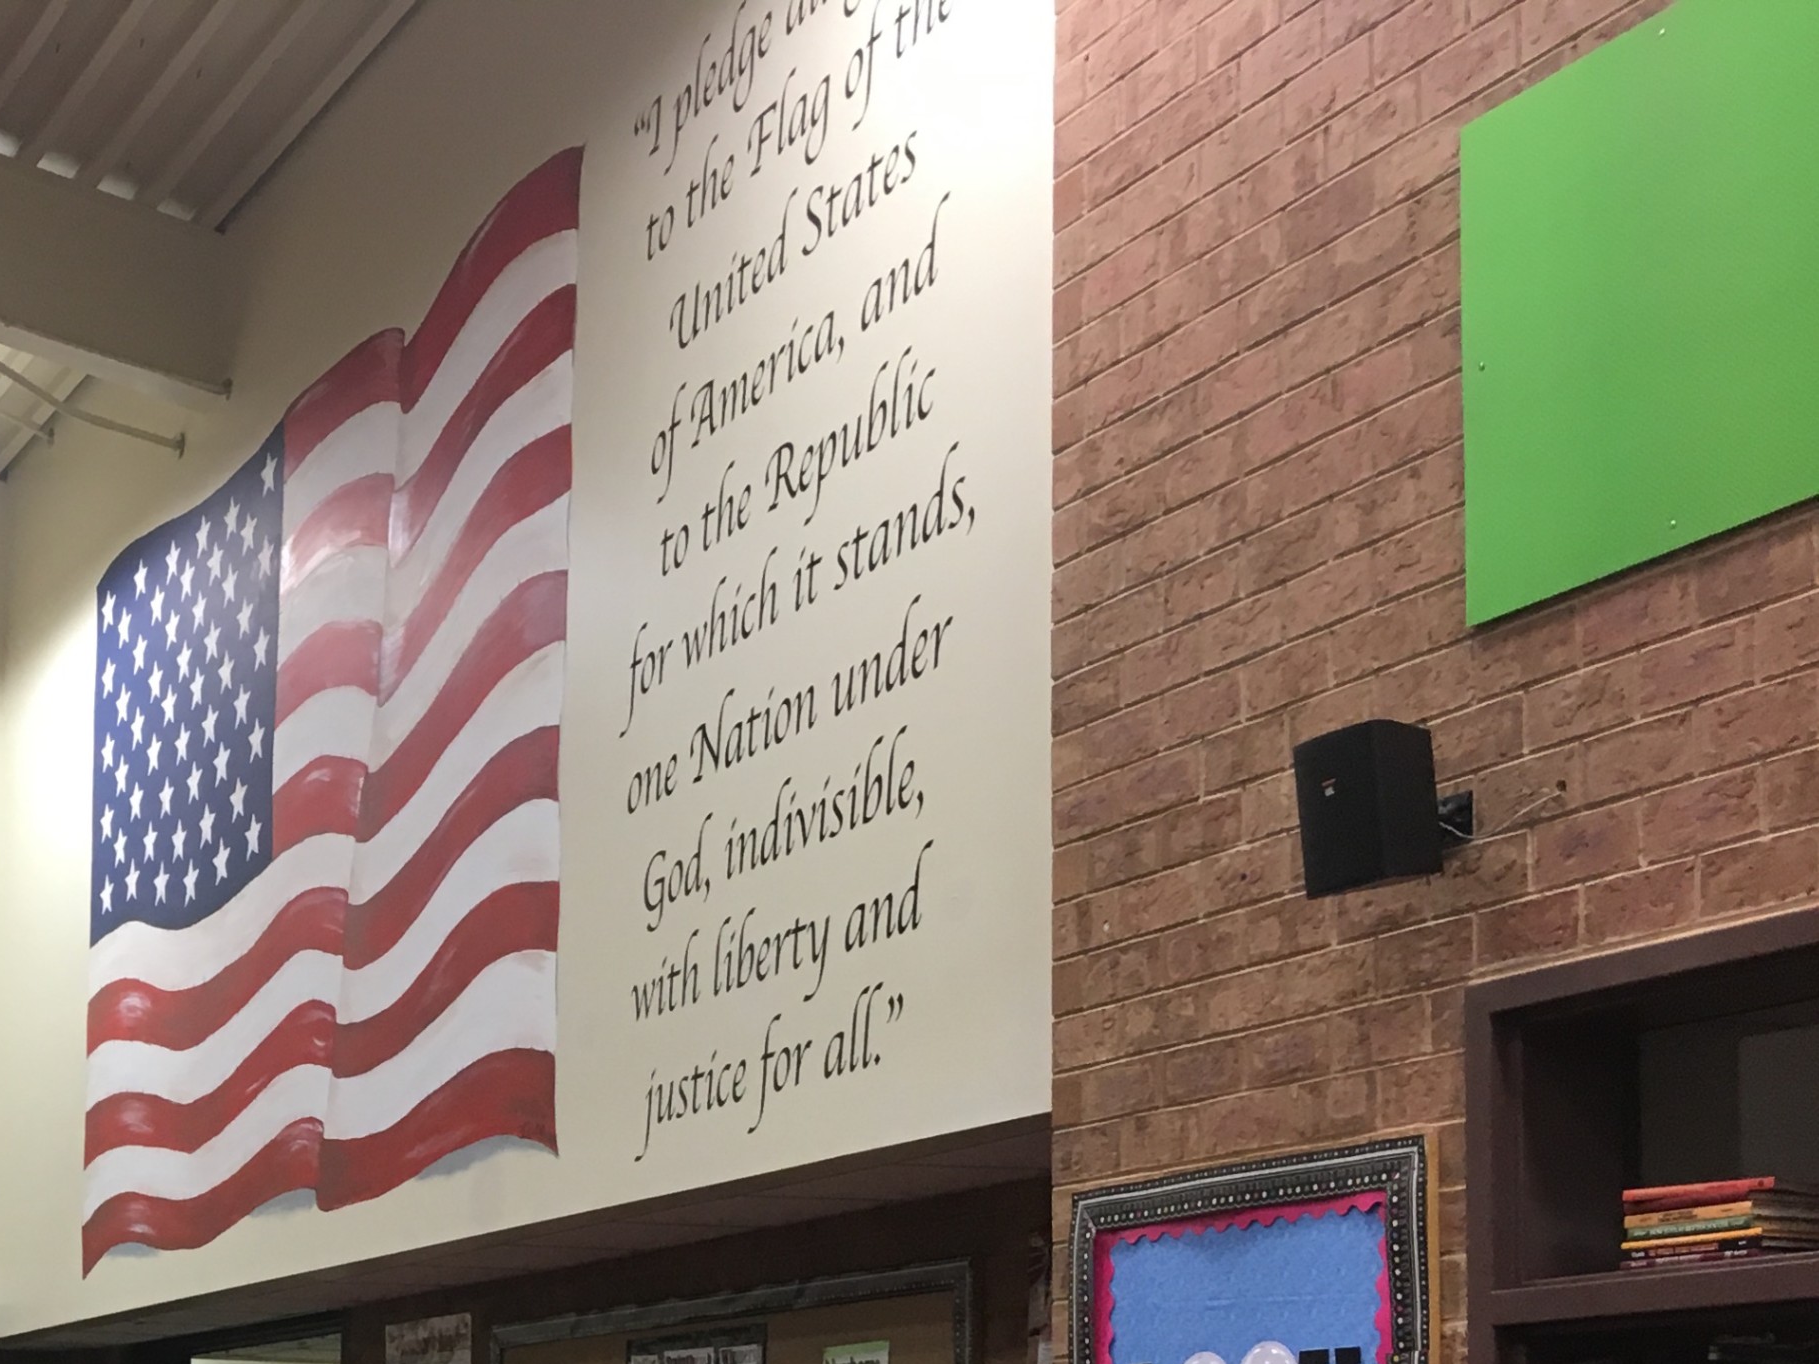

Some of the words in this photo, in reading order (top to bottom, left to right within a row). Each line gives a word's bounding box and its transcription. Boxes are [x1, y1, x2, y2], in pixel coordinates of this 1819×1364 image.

[646, 205, 675, 261] to
[686, 134, 735, 228] the
[748, 67, 831, 177] Flag
[844, 0, 883, 131] of
[664, 0, 773, 175] pledge
[651, 382, 687, 504] of
[691, 310, 845, 448] America,
[860, 192, 950, 331] and
[669, 188, 798, 349] United
[801, 131, 917, 256] States
[661, 525, 689, 577] to
[702, 461, 752, 551] the
[765, 346, 936, 526] Republic
[619, 622, 673, 738] for
[682, 546, 778, 668] which
[794, 548, 823, 611] it
[834, 441, 976, 590] stands,
[627, 754, 678, 814] one
[689, 687, 817, 783] Nation
[833, 594, 954, 716] under
[631, 929, 700, 1022] with
[713, 907, 831, 1002] liberty
[844, 839, 935, 953] and
[643, 812, 713, 932] God,
[726, 725, 925, 880] indivisible,
[634, 1049, 747, 1162] justice
[747, 1014, 813, 1134] for
